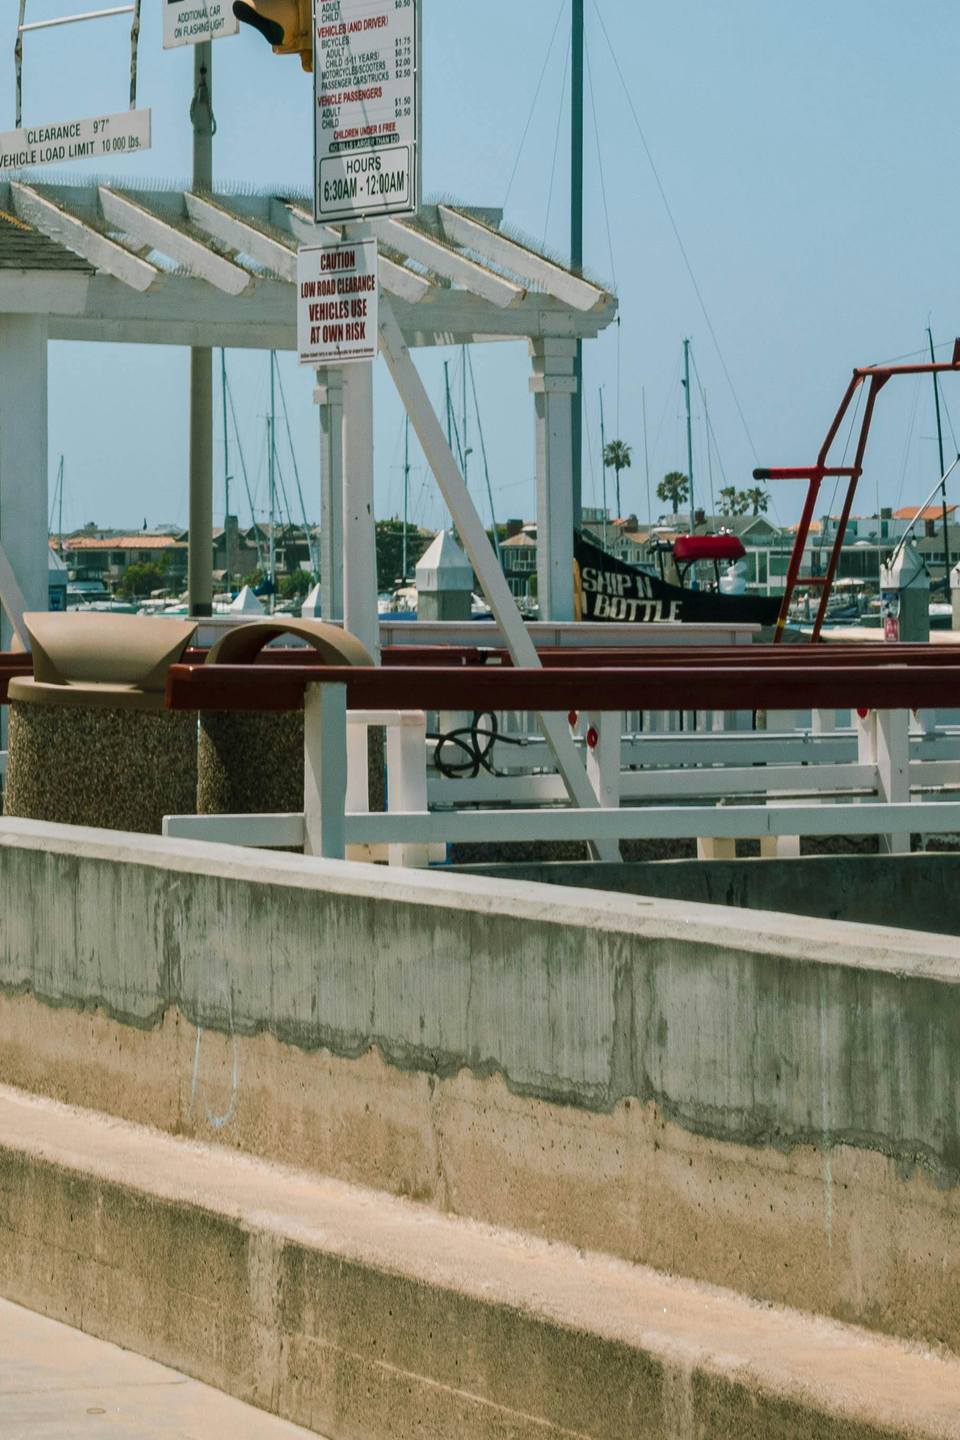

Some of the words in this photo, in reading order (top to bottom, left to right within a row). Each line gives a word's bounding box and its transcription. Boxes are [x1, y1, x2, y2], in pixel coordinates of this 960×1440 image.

[178, 8, 208, 24] ADDITIONAL
[210, 5, 220, 17] CAR
[322, 1, 340, 13] ADULT
[322, 12, 339, 23] CHILD
[395, 0, 410, 9] $0.50
[174, 25, 182, 38] ON
[183, 21, 209, 37] FLASHING
[210, 18, 225, 32] LIGHT
[317, 22, 346, 38] VEHICLES
[347, 19, 362, 35] (AND
[363, 16, 388, 31] DRIVER)
[326, 48, 345, 60] ADULT
[395, 37, 410, 47] $1.75
[326, 58, 342, 69] CHILD
[395, 48, 410, 57] $0.75
[395, 60, 410, 68] $2.00
[322, 78, 352, 91] PASSENGER
[395, 69, 410, 79] $2.50
[317, 93, 342, 107] VEHICLE
[343, 87, 382, 103] PASSENGERS
[322, 107, 340, 119] ADULT
[395, 96, 410, 106] $1.50
[322, 119, 339, 130] CHILD
[395, 108, 410, 118] $0.50
[27, 123, 81, 144] CLEARANCE
[334, 127, 359, 140] CHILDREN
[360, 124, 377, 136] UNDER
[382, 122, 396, 133] FREE
[40, 145, 65, 162] LOAD
[68, 141, 95, 158] LIMIT
[347, 157, 381, 173] HOURS
[324, 177, 357, 201] 6:30AM
[366, 171, 404, 195] 12:00AM
[320, 251, 355, 271] CAUTION
[301, 281, 316, 298] LOW
[317, 279, 336, 296] ROAD
[337, 274, 375, 295] CLEARANCE
[309, 300, 349, 322] VEHICLES
[351, 299, 367, 318] USE
[310, 326, 320, 344] AT
[322, 324, 343, 343] OWN
[345, 322, 366, 341] RISK
[582, 567, 632, 596] SHIP
[636, 576, 653, 598] N
[593, 594, 683, 623] BOTTLE
